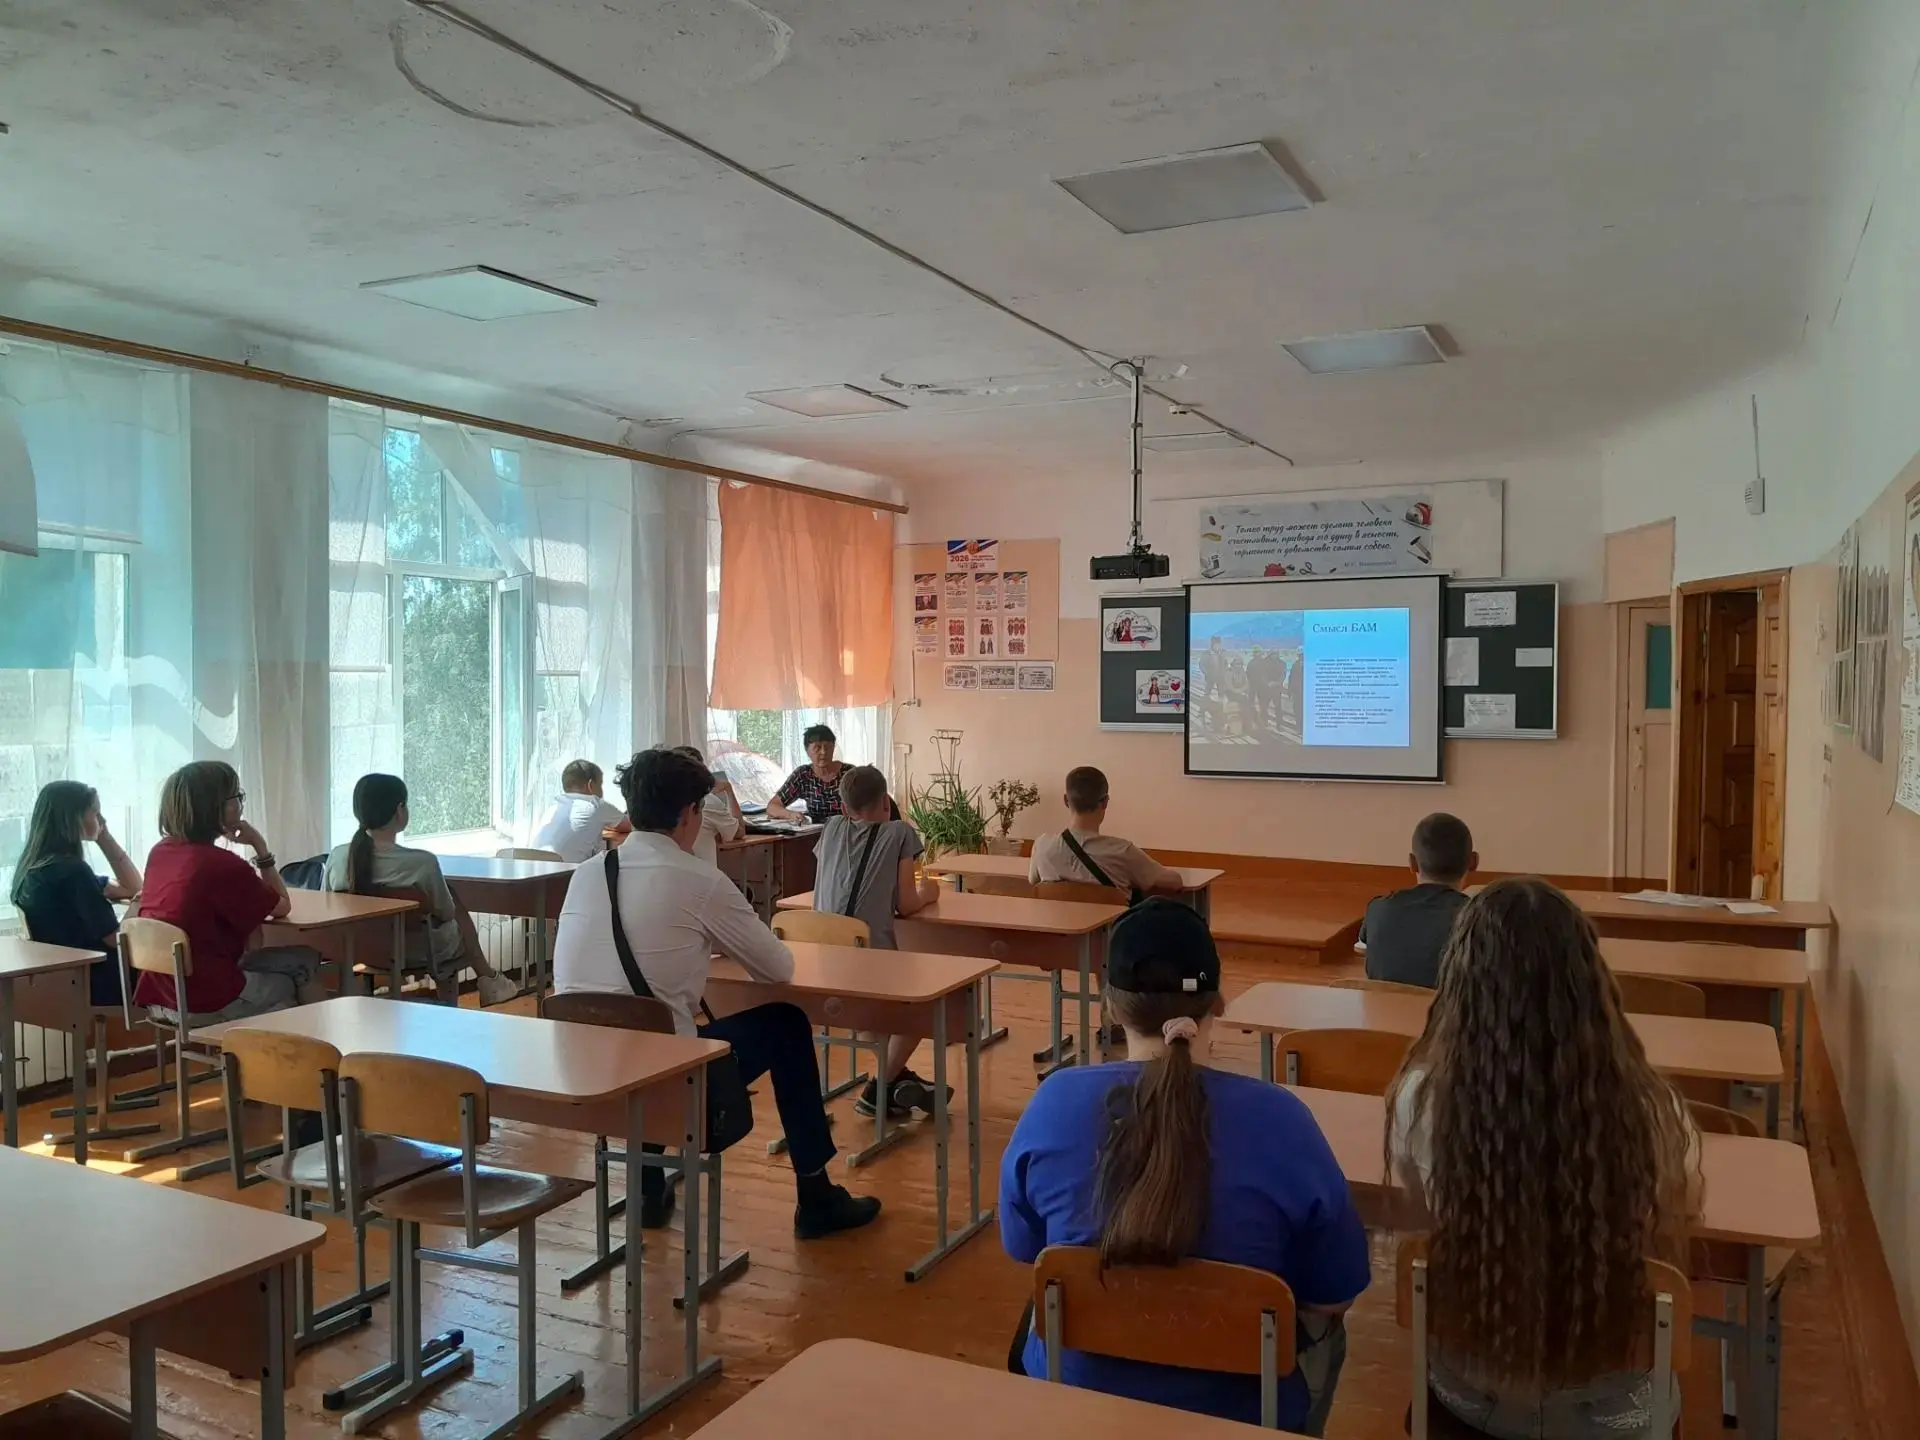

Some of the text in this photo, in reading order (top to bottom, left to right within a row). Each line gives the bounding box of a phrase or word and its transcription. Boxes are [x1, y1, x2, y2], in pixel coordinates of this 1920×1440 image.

[1235, 517, 1392, 535] Только труд может сделать человека
[1281, 532, 1314, 545] приводя
[1330, 533, 1353, 544] душу
[1355, 530, 1360, 539] в
[1284, 544, 1330, 558] довольство
[1312, 622, 1377, 633] Смысл БАМ
